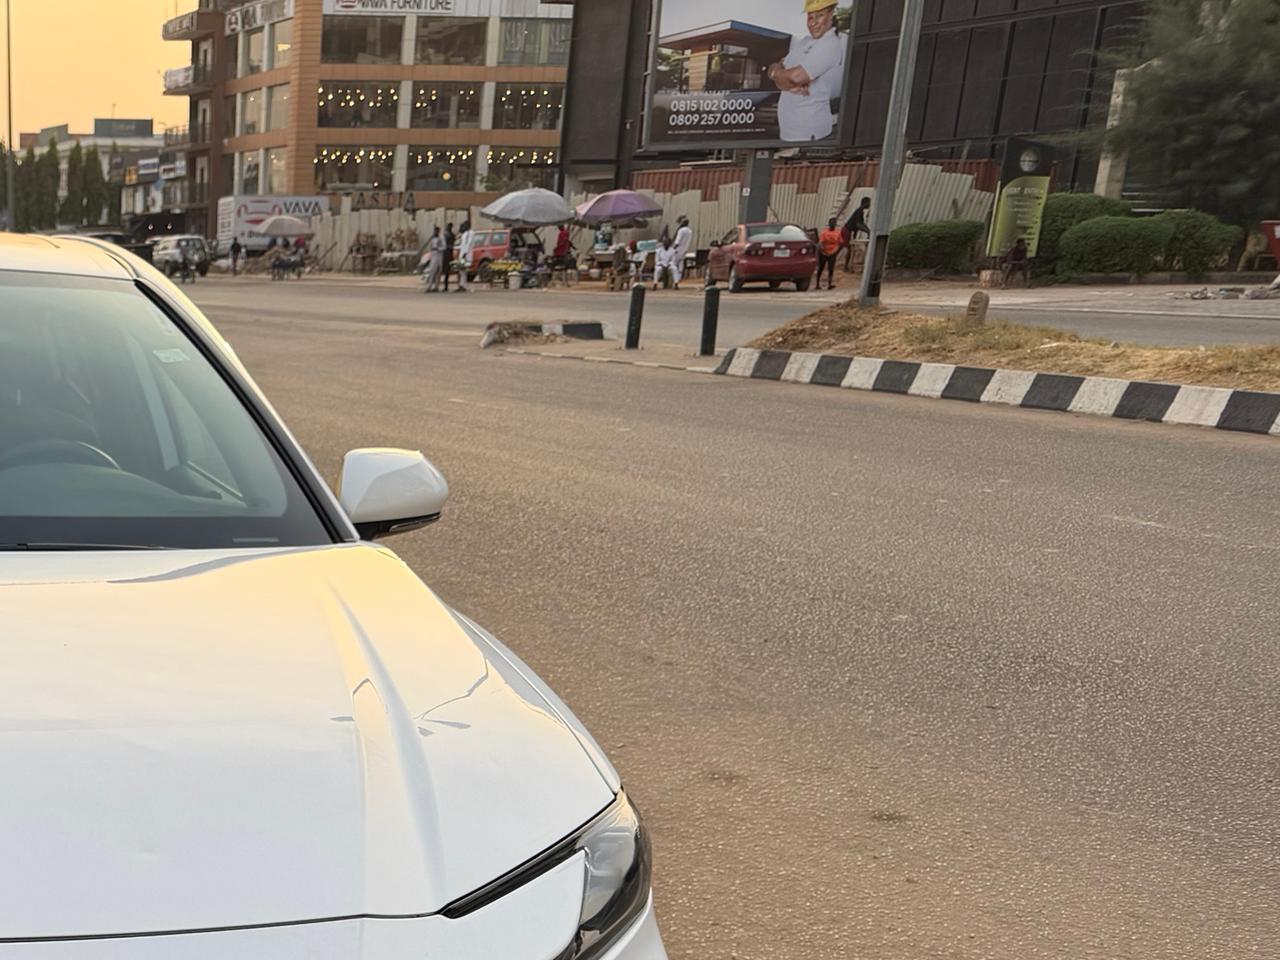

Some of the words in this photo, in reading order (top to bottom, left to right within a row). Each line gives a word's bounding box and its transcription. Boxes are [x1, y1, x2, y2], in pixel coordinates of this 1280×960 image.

[671, 100, 698, 111] 0815
[700, 99, 719, 111] 102
[720, 99, 756, 111] 0000,
[669, 114, 699, 126] 0809
[701, 113, 721, 125] 257
[722, 112, 755, 124] 0000
[283, 200, 321, 215] VAVA
